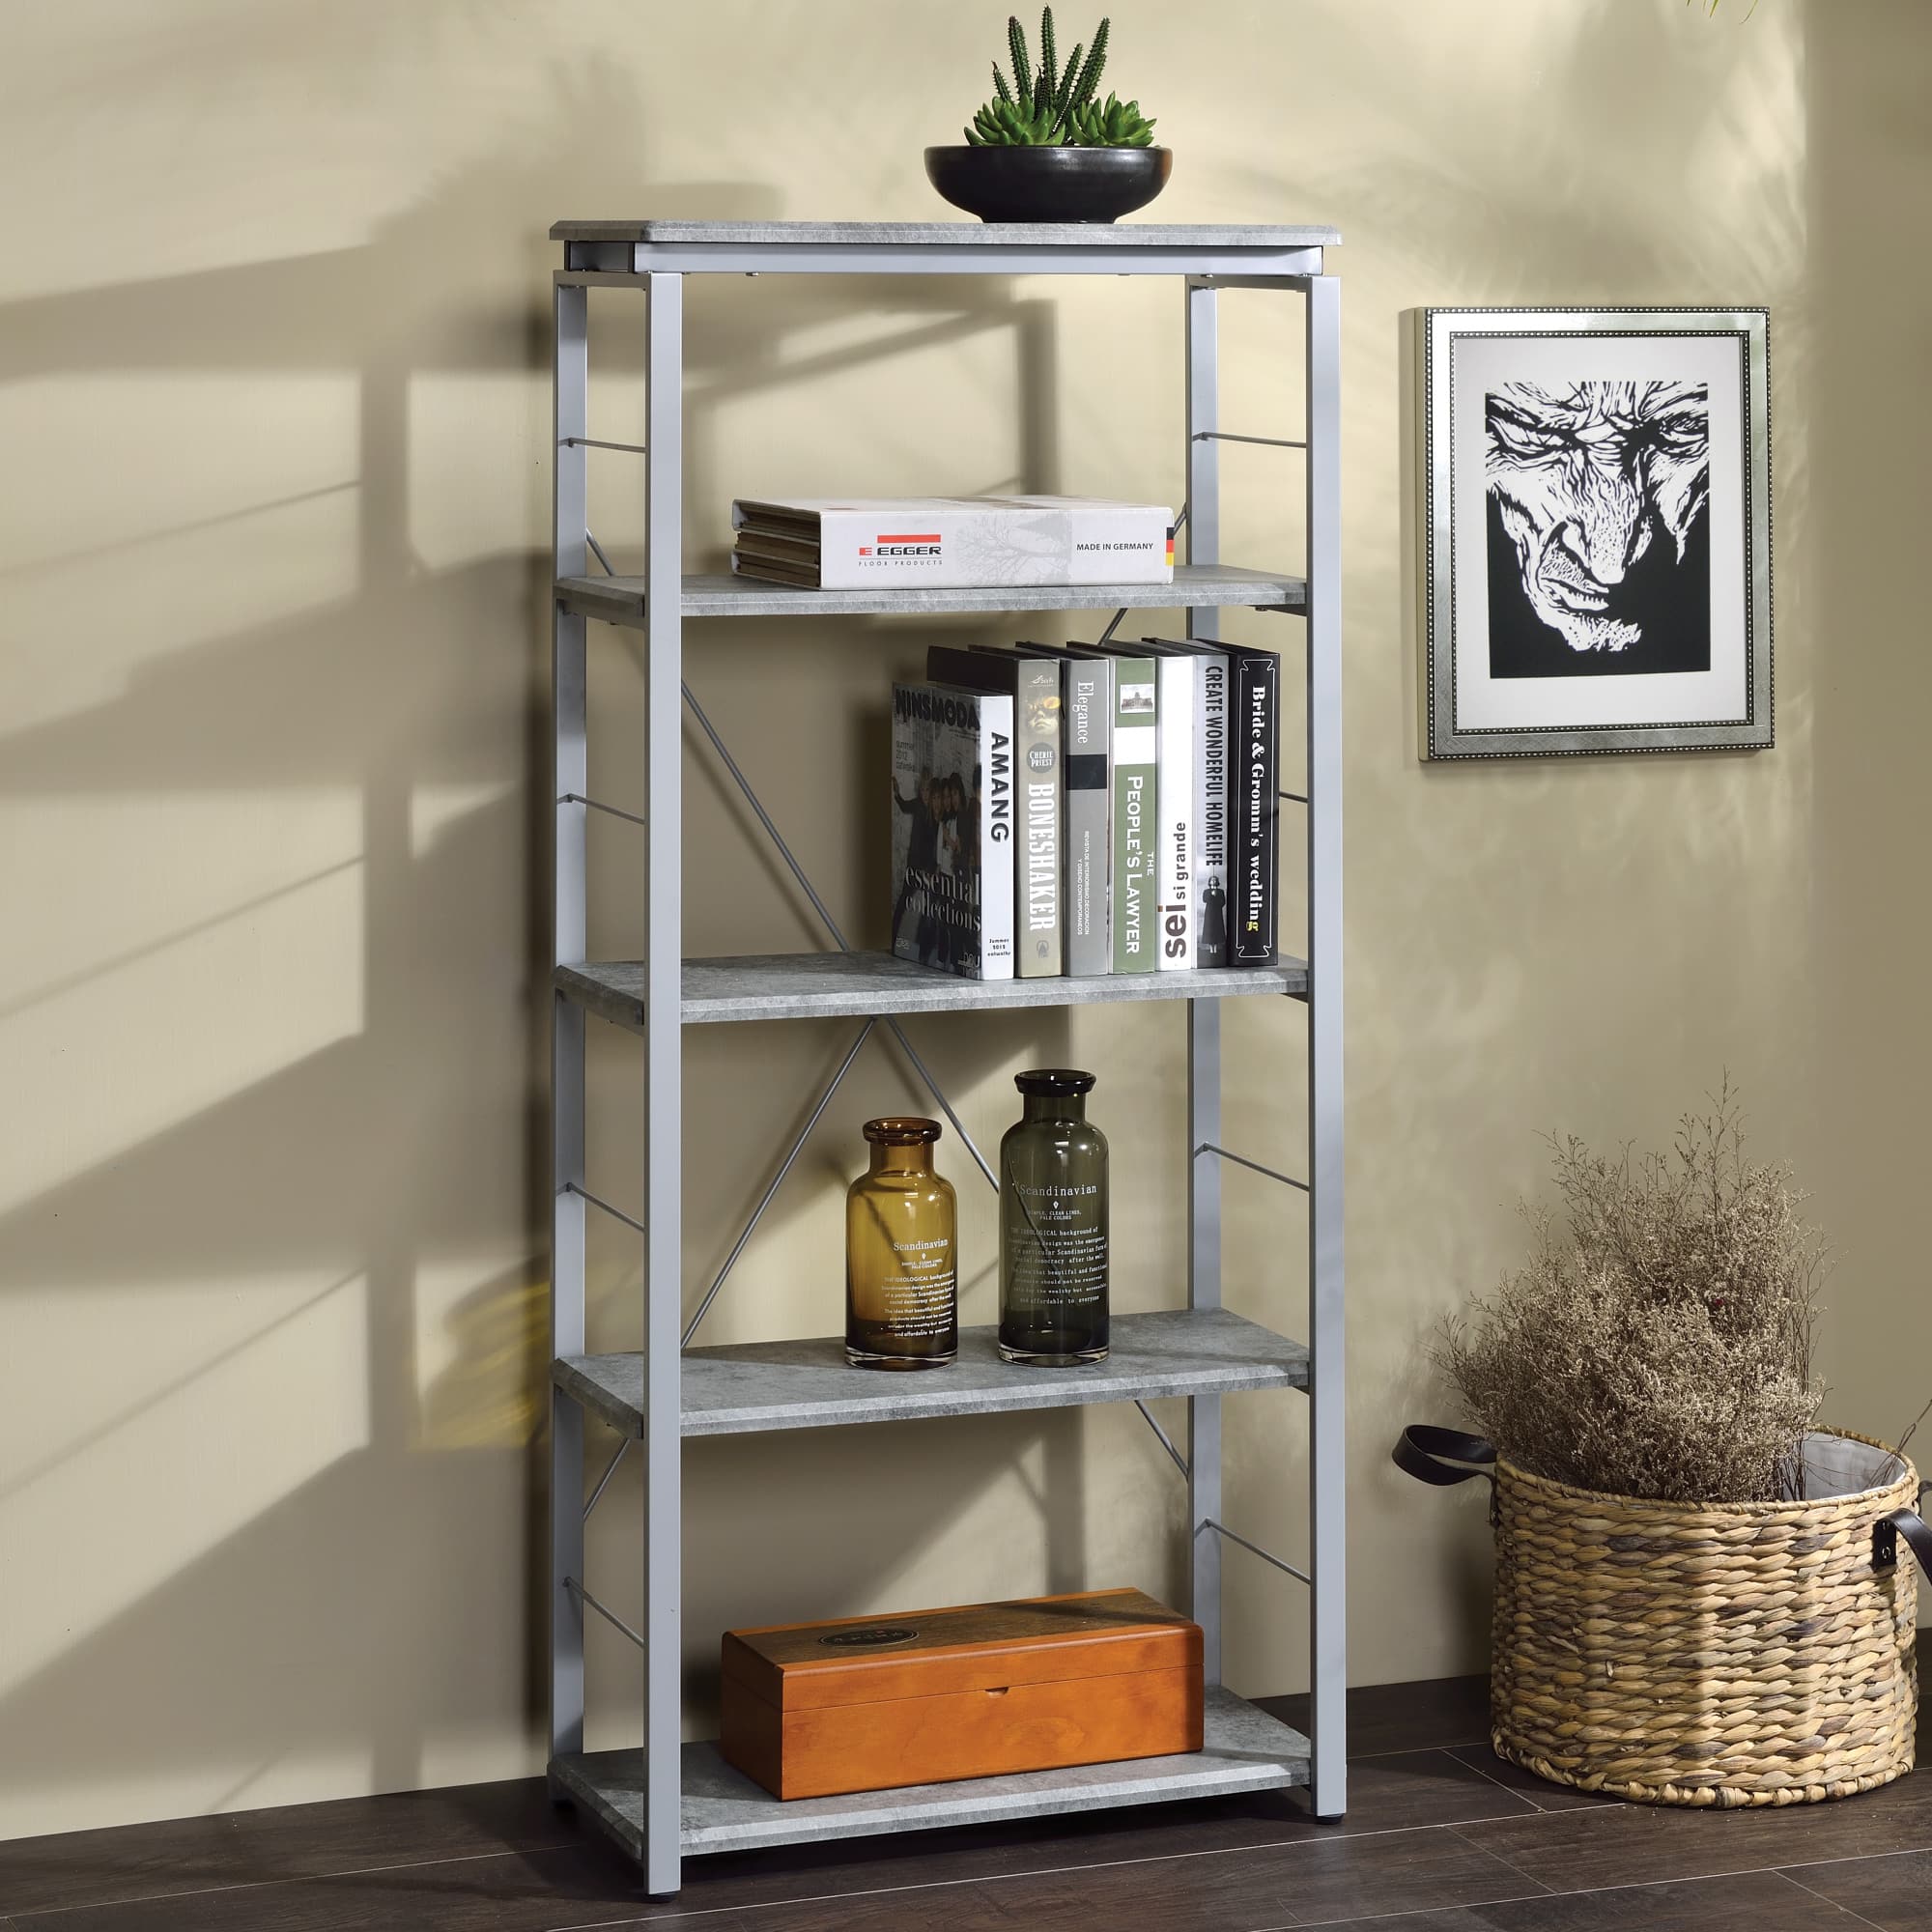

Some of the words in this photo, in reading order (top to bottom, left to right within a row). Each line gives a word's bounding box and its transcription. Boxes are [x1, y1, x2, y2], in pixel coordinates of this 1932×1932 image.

[877, 546, 942, 556] EGGER
[1113, 542, 1153, 551] GERMANY
[1205, 666, 1223, 712] CREATE
[1072, 680, 1094, 744] Elegance
[1252, 685, 1265, 739] Bride
[1029, 751, 1054, 759] CHERIE
[1031, 758, 1052, 768] PRIEST
[1206, 716, 1223, 797] WONDERFUL
[1251, 742, 1265, 759] &
[991, 731, 1009, 842] AMANG
[1250, 763, 1265, 847] Gromm's
[1126, 776, 1144, 868] PEOPLE'S
[1206, 802, 1223, 867] HOMELIFE
[1028, 782, 1056, 931] BONESHAKER
[1173, 822, 1189, 881] grande
[905, 866, 980, 905] essential
[1173, 886, 1186, 900] si
[1246, 854, 1264, 932] wedding
[905, 891, 981, 932] collections
[1125, 873, 1143, 954] LAWYER
[1019, 1183, 1097, 1197] Scandinavian
[893, 1237, 949, 1252] Scandinavian
[1057, 1246, 1094, 1256] Scandinavian
[1059, 1227, 1092, 1236] background
